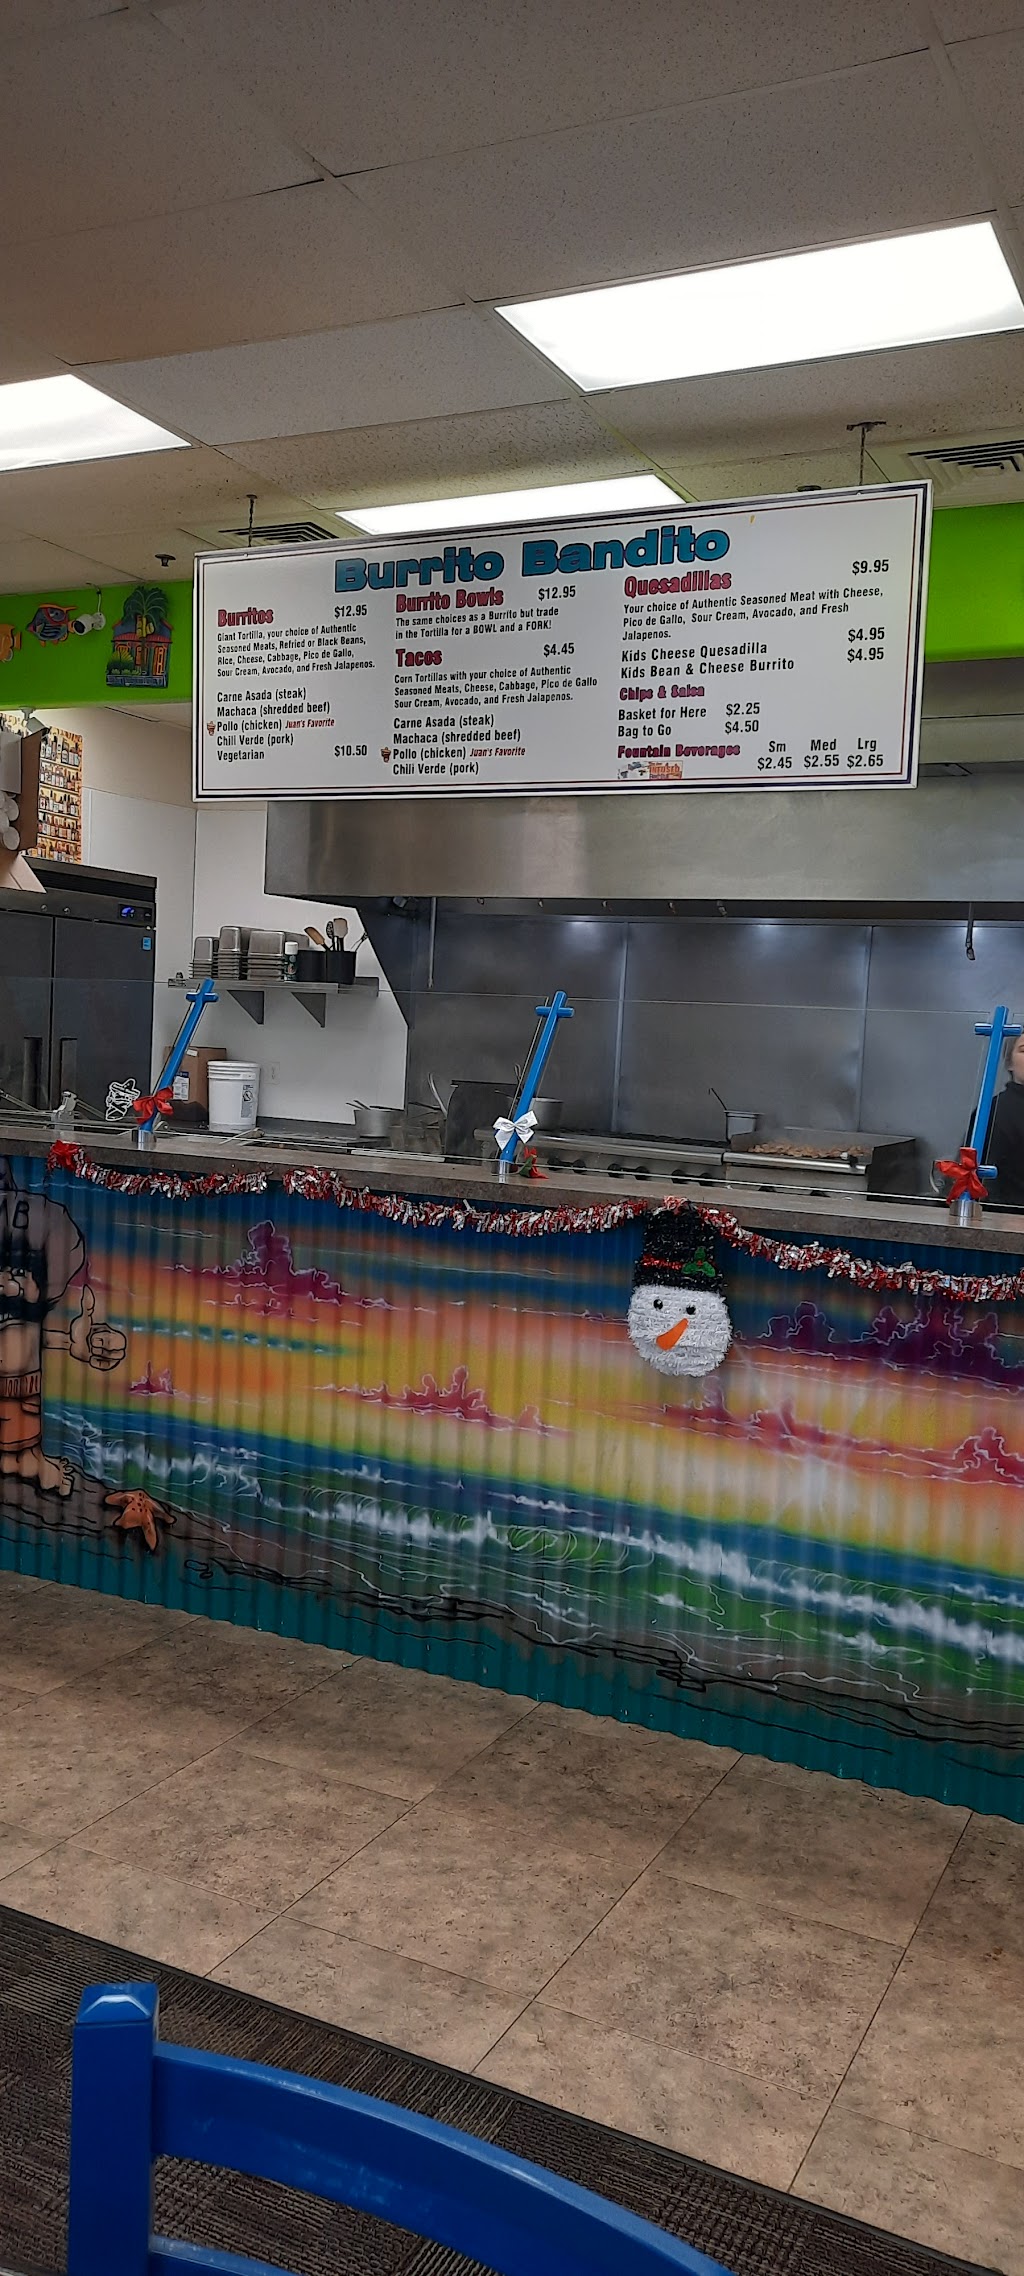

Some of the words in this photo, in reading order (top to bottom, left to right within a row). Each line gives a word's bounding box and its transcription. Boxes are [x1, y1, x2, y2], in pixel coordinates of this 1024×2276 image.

[335, 546, 504, 593] Burrito
[522, 524, 730, 577] Bandito
[852, 559, 889, 576] $9.95
[624, 569, 732, 599] Quesadillas
[396, 591, 451, 613] Burrito
[455, 586, 504, 609] Bowls
[538, 585, 576, 602] $12.95
[624, 604, 644, 614] Your
[647, 601, 677, 612] choice
[680, 599, 689, 610] of
[691, 596, 737, 609] Authentic
[740, 592, 787, 606] Seasoned
[790, 590, 815, 602] Meat
[818, 589, 839, 600] with
[843, 587, 883, 598] Cheese,
[217, 606, 274, 627] Burritos
[334, 604, 367, 619] $12.95
[396, 617, 410, 627] The
[412, 617, 433, 626] same
[435, 613, 466, 624] choices
[489, 609, 517, 620] Burrito
[520, 608, 534, 618] but
[536, 606, 559, 617] trade
[623, 617, 643, 628] Pico
[645, 616, 656, 626] de
[659, 614, 686, 625] Gallo,
[691, 612, 713, 623] Sour
[715, 611, 749, 621] Cream,
[752, 606, 796, 619] Avocado,
[799, 604, 818, 616] and
[821, 602, 849, 614] Fresh
[217, 632, 236, 642] Giant
[237, 630, 265, 640] Tortilla,
[267, 630, 283, 640] your
[285, 627, 309, 637] choice
[311, 625, 319, 635] of
[320, 623, 357, 634] Authentic
[395, 630, 403, 640] in
[405, 629, 418, 639] the
[420, 627, 449, 638] Tortilla
[451, 627, 463, 636] for
[473, 623, 497, 634] BOWL
[499, 622, 515, 633] and
[518, 623, 523, 632] a
[526, 620, 552, 631] FORK!
[622, 630, 671, 642] Jalapenos.
[848, 627, 885, 643] $4.95
[217, 643, 251, 654] Seasoned
[253, 641, 278, 651] Meats,
[279, 639, 305, 649] Refried
[317, 637, 338, 647] Black
[340, 636, 366, 645] Beans,
[543, 642, 575, 658] $4.45
[621, 649, 646, 662] Kids
[651, 648, 695, 661] Cheese
[700, 642, 767, 659] Quesadilla
[217, 656, 235, 666] Rice,
[237, 655, 265, 664] Cheese,
[267, 652, 301, 663] Cabbage,
[303, 650, 319, 660] Pico
[321, 649, 331, 659] de
[333, 648, 354, 658] Gallo,
[395, 648, 443, 667] Tacos
[847, 647, 884, 663] $4.95
[217, 668, 233, 677] Sour
[235, 667, 260, 676] Cream,
[262, 664, 294, 674] Avocado,
[296, 663, 310, 672] and
[312, 661, 332, 671] Fresh
[334, 660, 375, 671] Jalapenos.
[394, 674, 413, 684] Corn
[415, 672, 448, 683] Tortillas
[450, 671, 467, 681] with
[469, 671, 487, 682] your
[489, 668, 517, 679] choice
[519, 667, 528, 677] of
[530, 665, 571, 676] Authentic
[621, 666, 645, 679] Kids
[650, 665, 680, 677] Bean
[685, 663, 694, 675] &
[699, 662, 744, 674] Cheese
[750, 658, 794, 671] Burrito
[217, 692, 242, 703] Carne
[245, 689, 272, 701] Asada
[275, 687, 306, 702] (steak)
[394, 685, 432, 696] Seasoned
[434, 684, 462, 694] Meats,
[464, 683, 497, 693] Cheese,
[499, 680, 538, 692] Cabbage,
[541, 679, 559, 689] Pico
[562, 678, 573, 688] de
[575, 677, 597, 687] Gallo
[619, 686, 654, 703] Chips
[657, 685, 667, 699] &
[670, 684, 705, 698] Salsa
[394, 699, 412, 709] Sour
[414, 698, 442, 708] Cream,
[445, 695, 481, 706] Avocado,
[483, 694, 499, 704] and
[502, 693, 525, 704] Fresh
[527, 692, 573, 704] Jalapenos.
[217, 706, 257, 717] Machaca
[260, 702, 304, 718] (shredded
[307, 701, 330, 714] beef)
[618, 708, 656, 721] Basket
[660, 707, 676, 719] for
[680, 706, 707, 718] Here
[725, 702, 760, 717] $2.25
[217, 721, 238, 732] Pollo
[241, 718, 282, 733] (chicken)
[285, 719, 306, 729] Juan's
[307, 718, 335, 728] Favorite
[393, 717, 422, 729] Carne
[425, 715, 455, 728] Asada
[459, 714, 494, 729] (steak)
[724, 719, 759, 735] $4.50
[217, 735, 236, 746] Chili
[239, 734, 264, 745] Verde
[267, 733, 294, 747] (pork)
[393, 732, 438, 744] Machaca
[441, 729, 491, 745] (shredded
[494, 728, 521, 742] beef)
[618, 725, 639, 739] Bag
[642, 725, 653, 736] to
[657, 724, 672, 736] Go
[334, 744, 367, 758] $10.50
[393, 748, 417, 760] Pollo
[420, 746, 466, 761] (chicken)
[469, 748, 493, 757] Juan's
[494, 746, 526, 756] Favorite
[617, 744, 671, 759] Fountain
[675, 744, 741, 758] Beverages
[768, 740, 786, 753] Sm
[810, 738, 837, 751] Med
[857, 737, 877, 752] Lrg
[217, 749, 265, 763] Vegetarian
[757, 756, 792, 771] $2.45
[803, 754, 840, 770] $2.55
[846, 754, 884, 769] $2.65
[393, 763, 415, 775] Chili
[417, 763, 446, 774] Verde
[449, 761, 479, 776] (pork)
